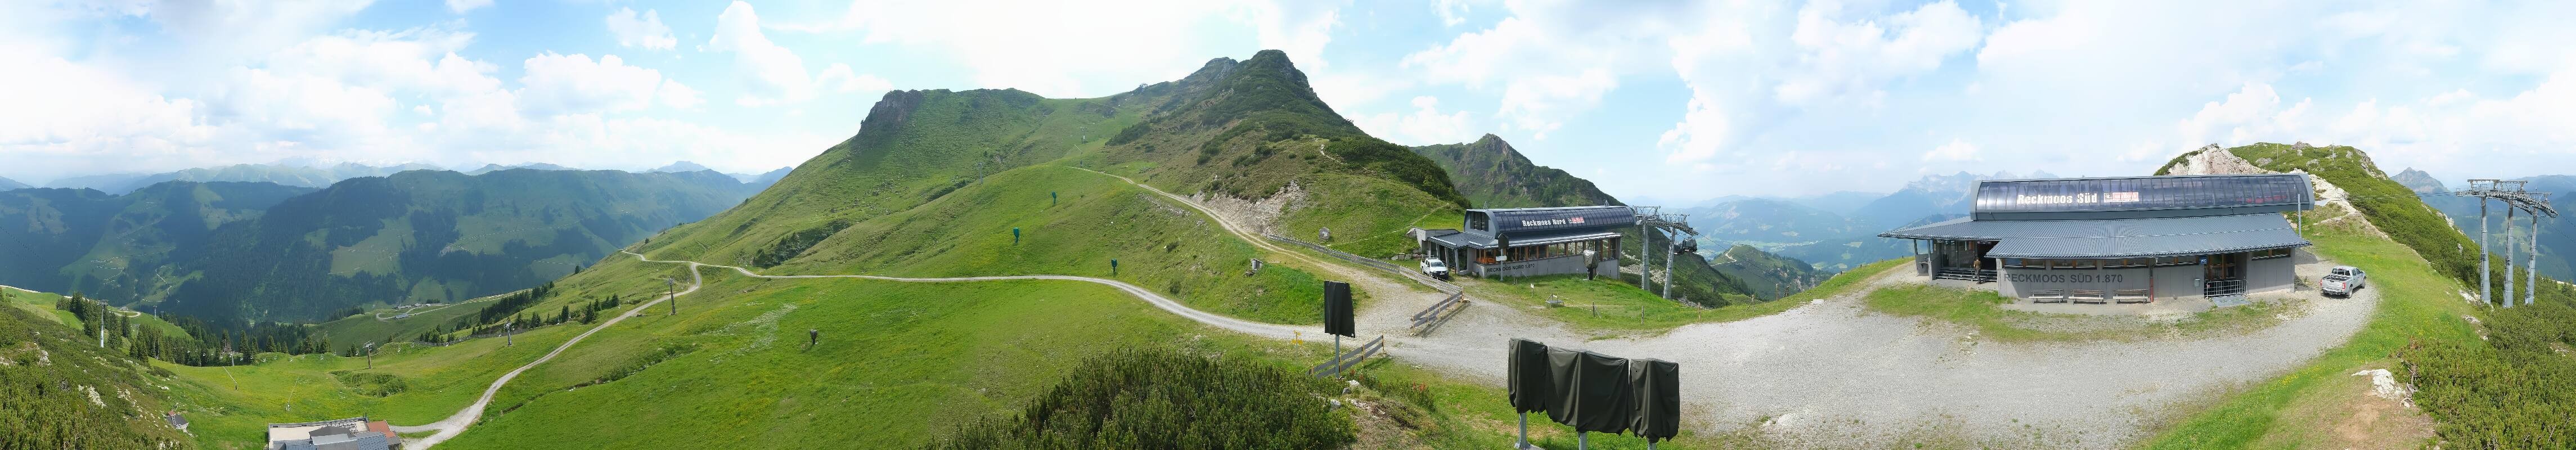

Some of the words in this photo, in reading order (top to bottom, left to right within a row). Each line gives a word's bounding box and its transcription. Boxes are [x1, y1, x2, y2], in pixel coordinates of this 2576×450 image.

[2016, 194, 2073, 204] Reckmoos
[2076, 192, 2097, 203] Süd
[2004, 273, 2065, 282] RECKMOOS
[2070, 273, 2092, 282] SÜD
[2096, 273, 2123, 282] 1.870
